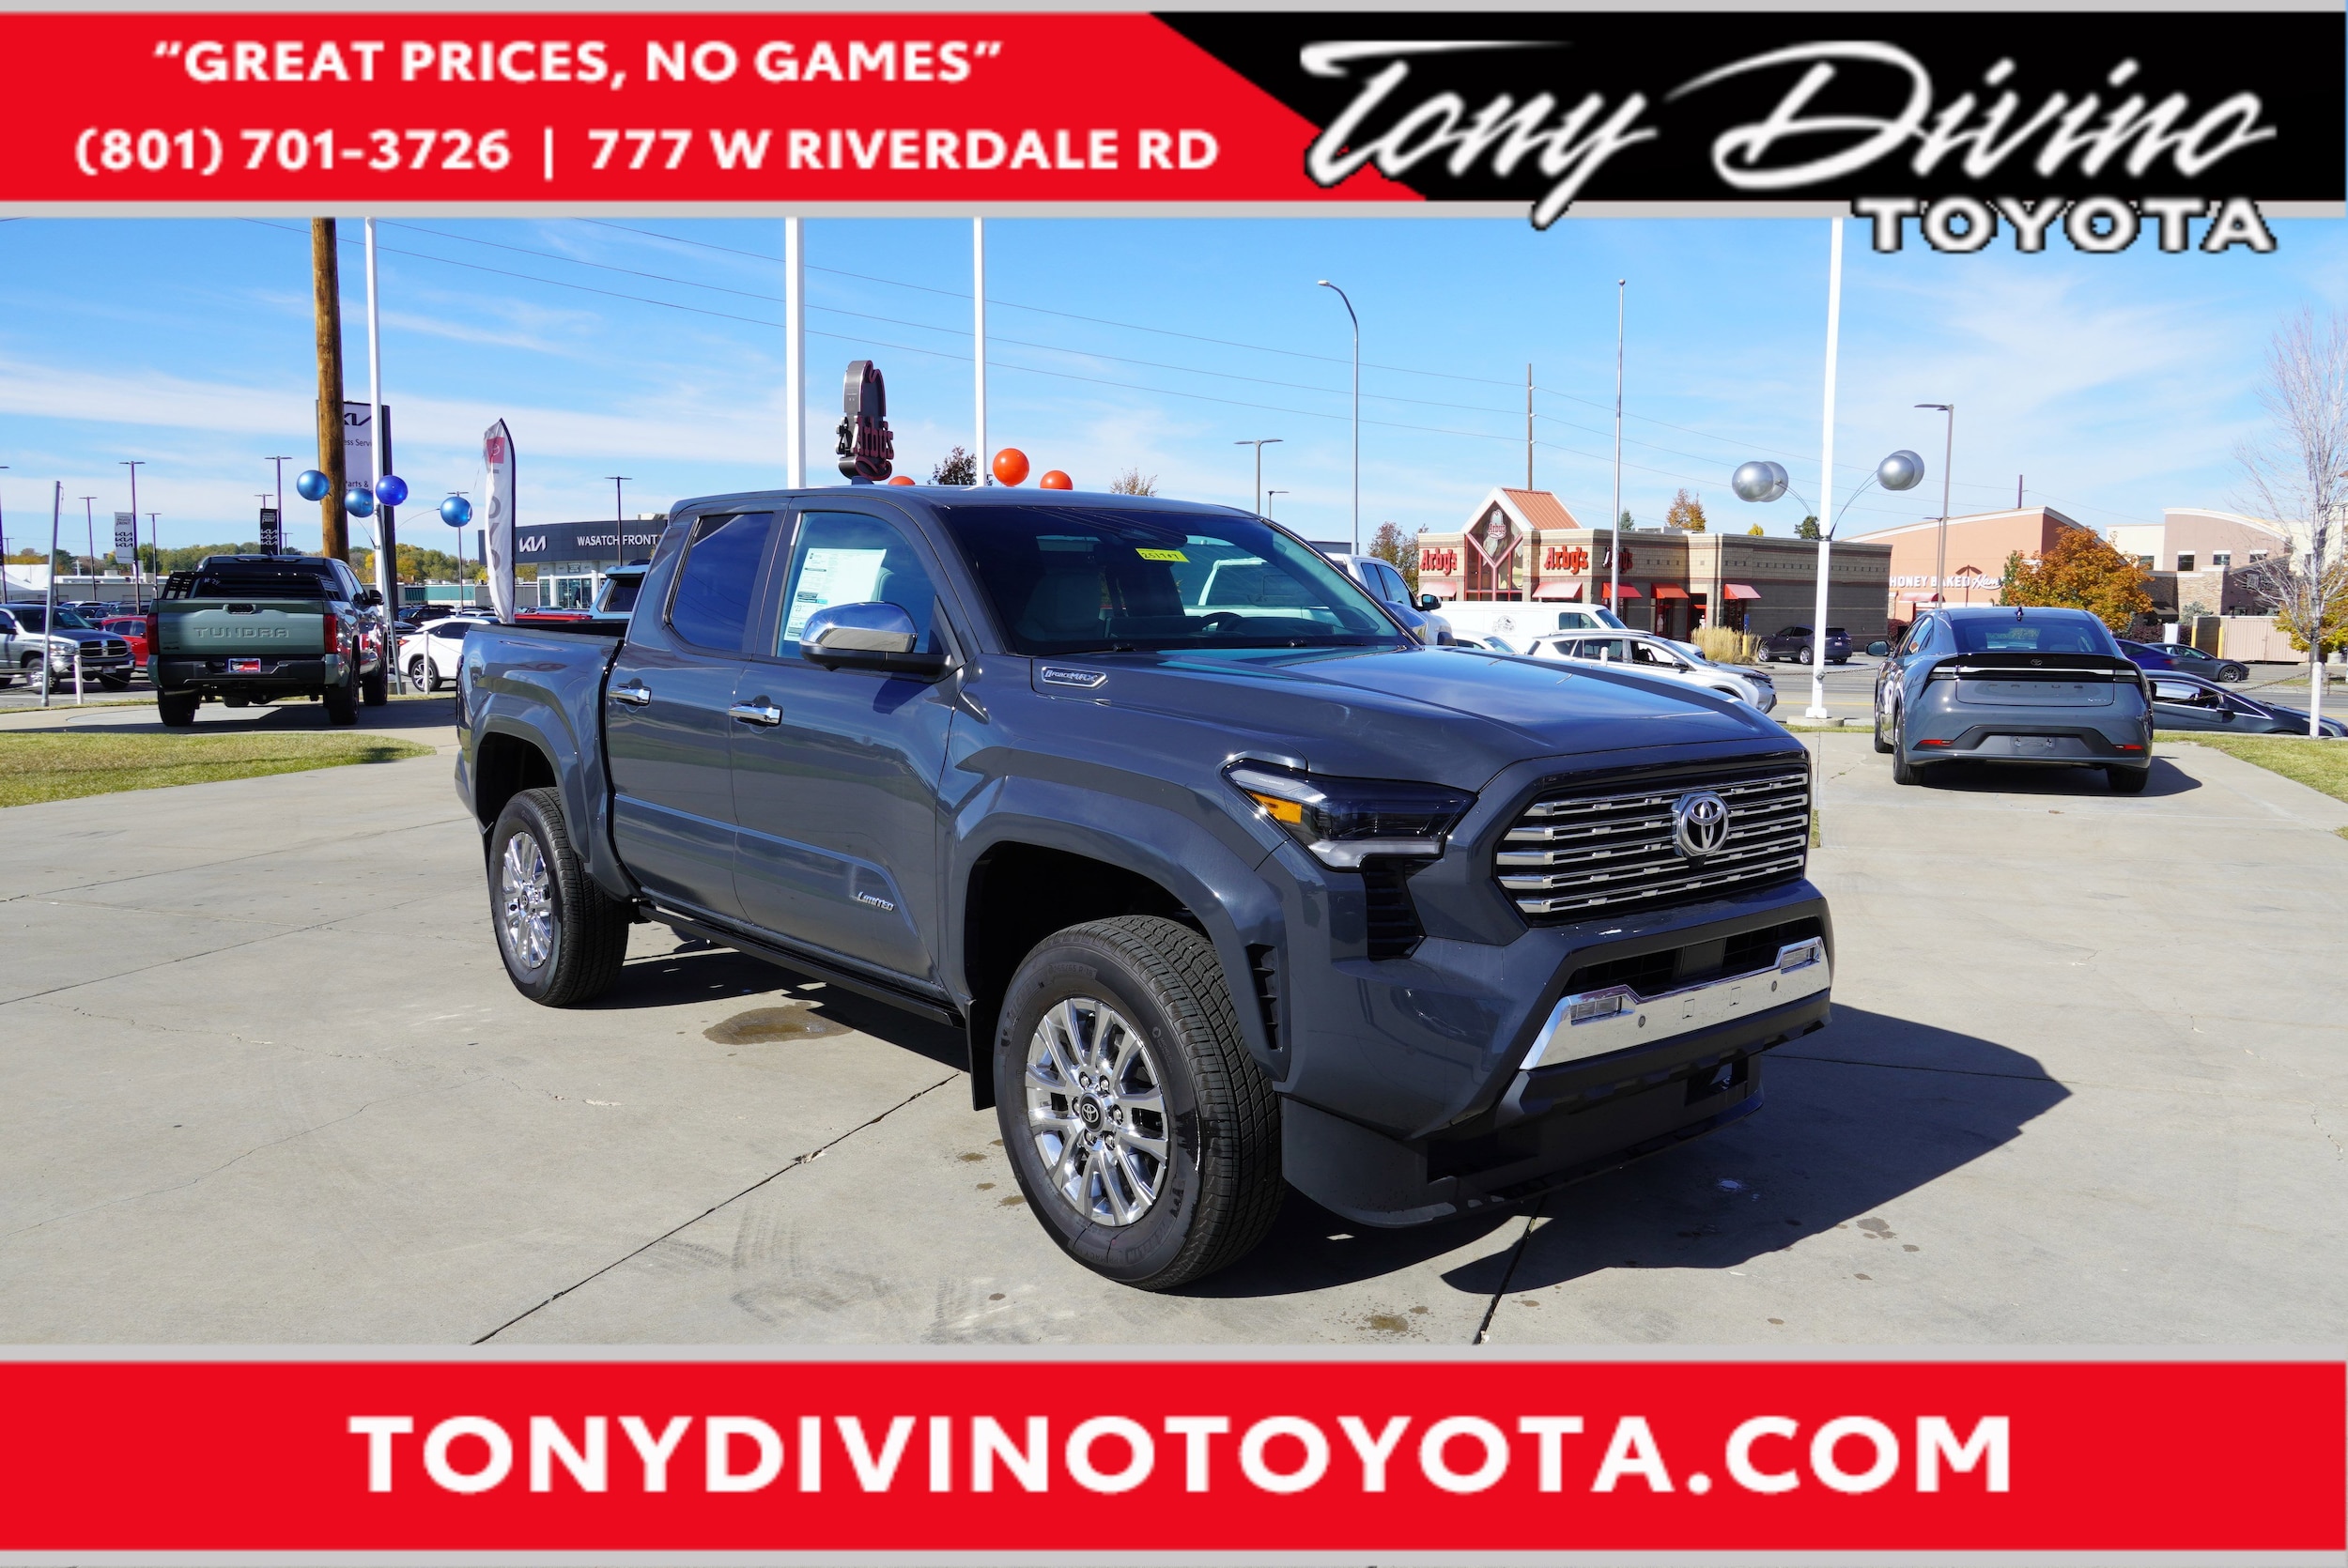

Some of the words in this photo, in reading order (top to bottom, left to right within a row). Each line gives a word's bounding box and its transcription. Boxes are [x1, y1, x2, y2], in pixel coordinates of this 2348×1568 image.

[518, 535, 548, 553] KIA
[577, 535, 620, 546] WASATCH
[622, 534, 658, 546] FRONT
[1419, 547, 1458, 576] Arby's
[1544, 546, 1589, 575] Arby's
[1889, 576, 1928, 588] HONEY
[193, 627, 289, 638] TUNDRA
